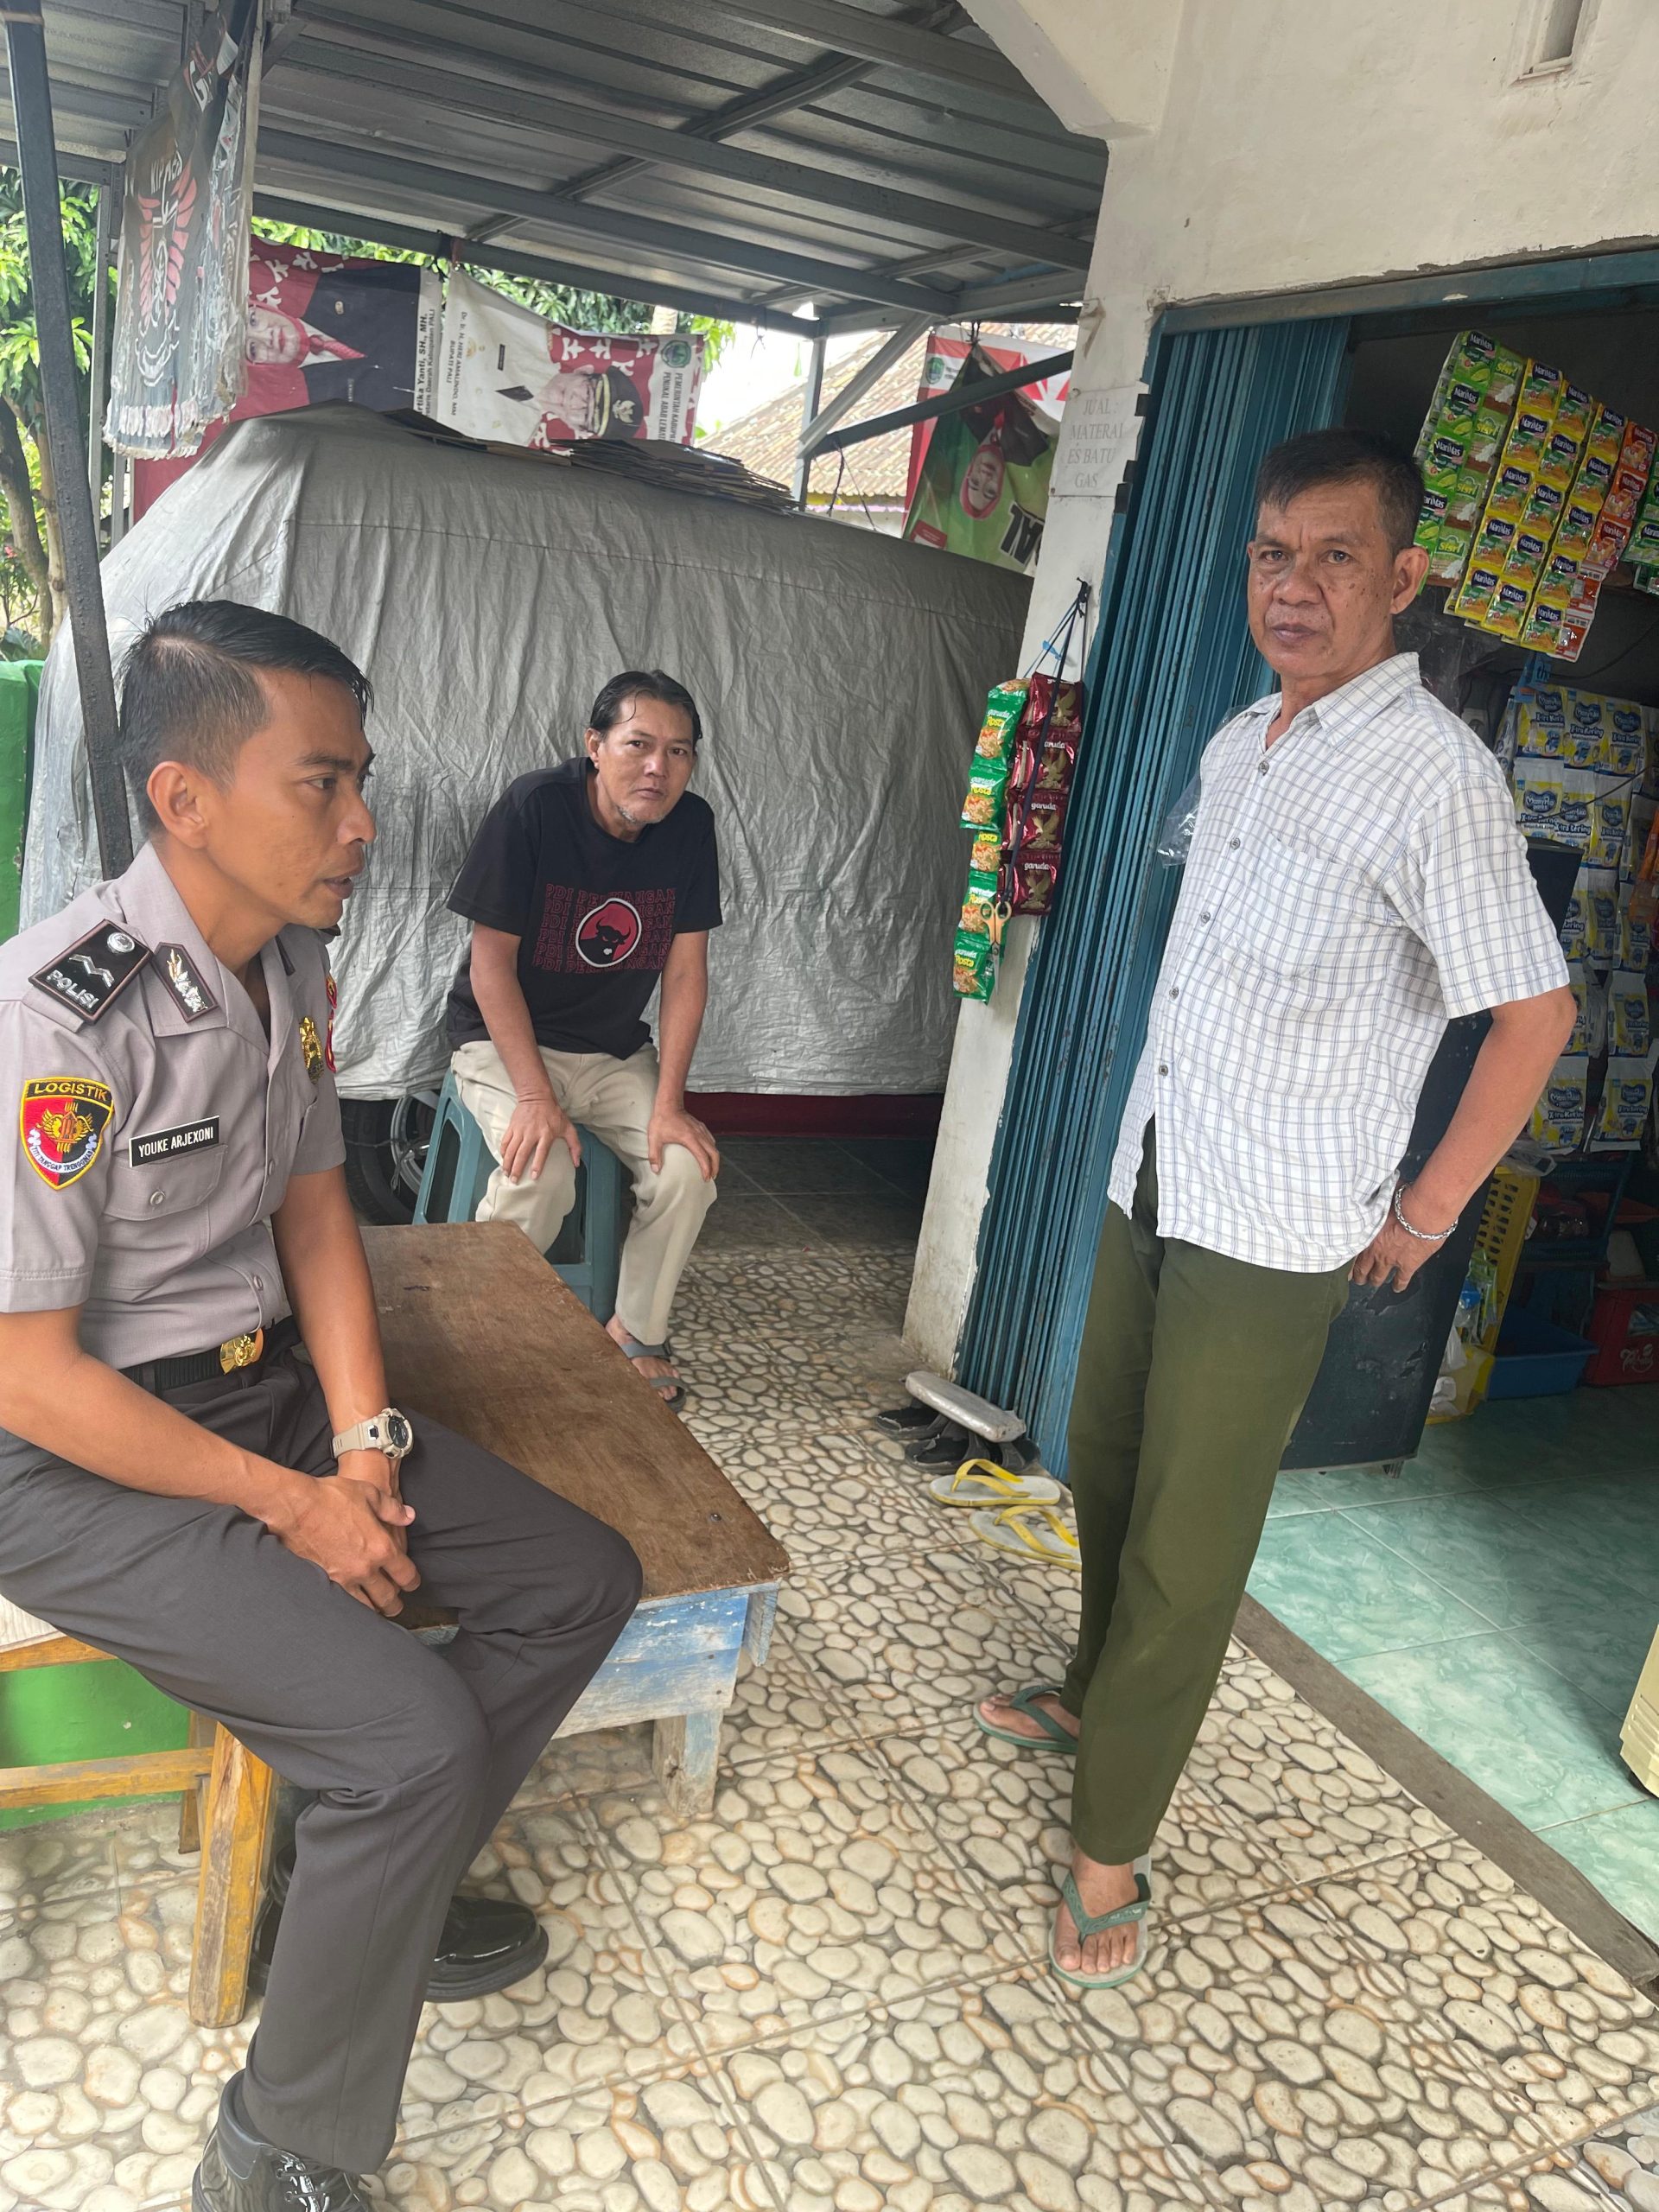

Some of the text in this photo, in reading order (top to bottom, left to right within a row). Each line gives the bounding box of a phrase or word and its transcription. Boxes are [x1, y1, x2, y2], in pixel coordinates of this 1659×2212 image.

[417, 358, 427, 385] Yanti,
[661, 372, 671, 398] PENUKAL
[672, 372, 683, 413] PEMERINTAH
[416, 388, 425, 414] rtika
[660, 401, 669, 418] ABAB
[1082, 398, 1111, 415] JUAL
[1066, 448, 1116, 465] ES BATU
[1074, 472, 1099, 488] GAS
[1424, 495, 1446, 509] ariMas
[1044, 741, 1065, 749] aruda
[978, 833, 998, 842] Rosta
[1024, 862, 1050, 871] garuda
[546, 883, 575, 902] PDI
[543, 899, 571, 916] PDI
[538, 928, 566, 944] PDI
[536, 942, 564, 959] PDI
[532, 955, 563, 973] PDI
[955, 955, 975, 968] Rosta
[46, 969, 99, 1010] POLISI
[34, 1082, 108, 1102] LOGISTIK
[138, 1126, 214, 1158] YOUKE ARJEXONI
[37, 1154, 62, 1171] TANGGAP
